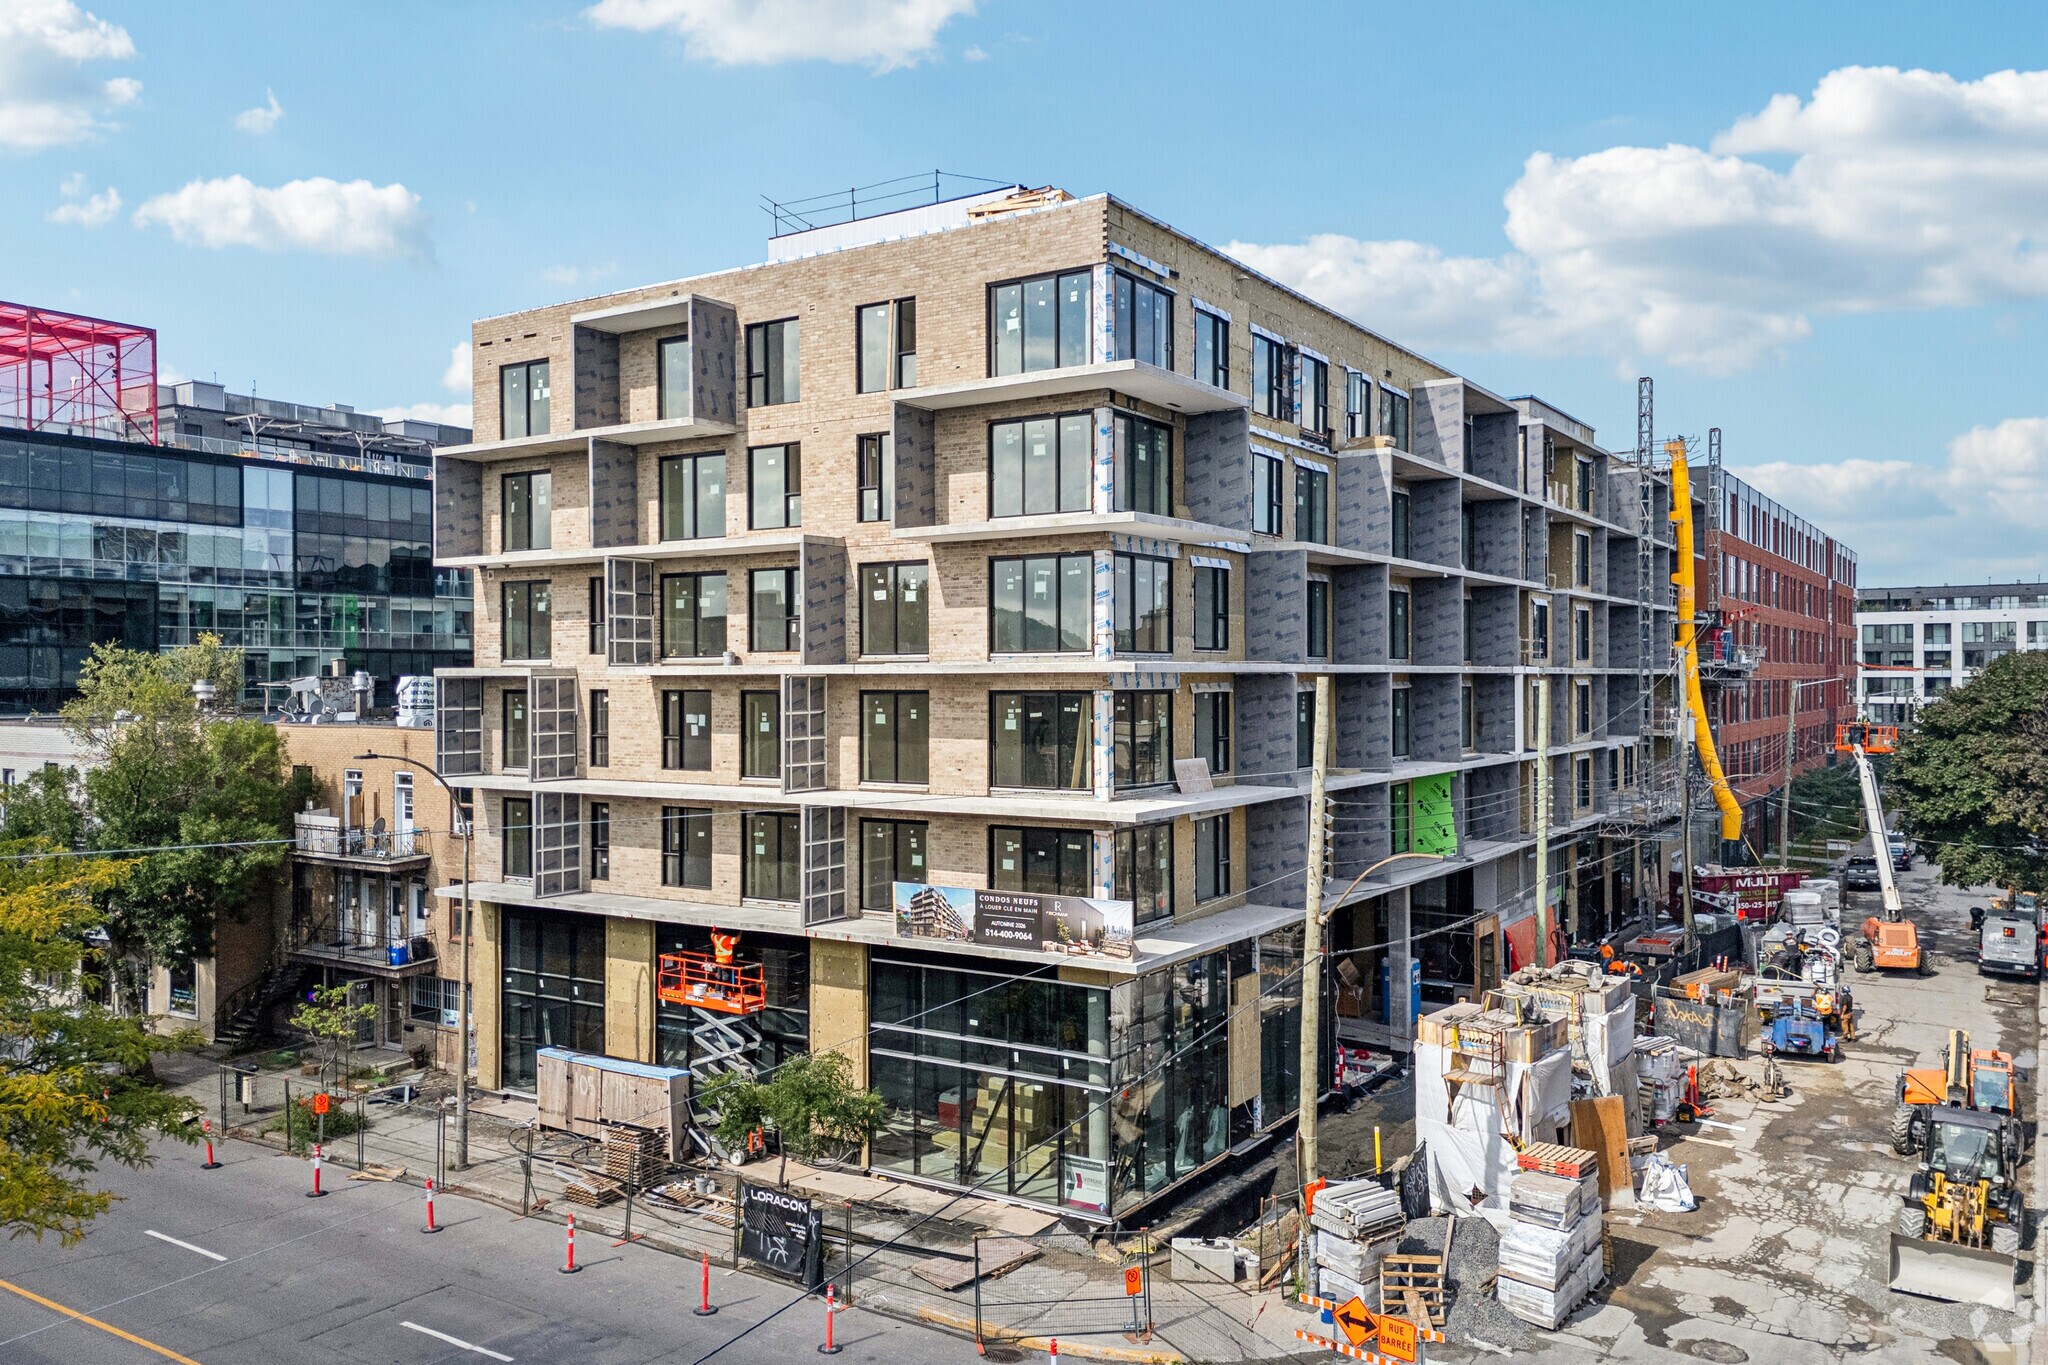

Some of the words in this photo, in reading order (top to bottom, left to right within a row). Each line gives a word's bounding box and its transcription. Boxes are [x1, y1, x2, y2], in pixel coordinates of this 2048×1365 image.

[979, 895, 1010, 904] CONDOS
[1013, 897, 1038, 906] NEUFS
[985, 929, 1033, 941] 514-400-9064
[751, 1189, 808, 1213] LORACON
[1388, 1323, 1405, 1336] RUE
[1381, 1335, 1412, 1353] BARRÉE
